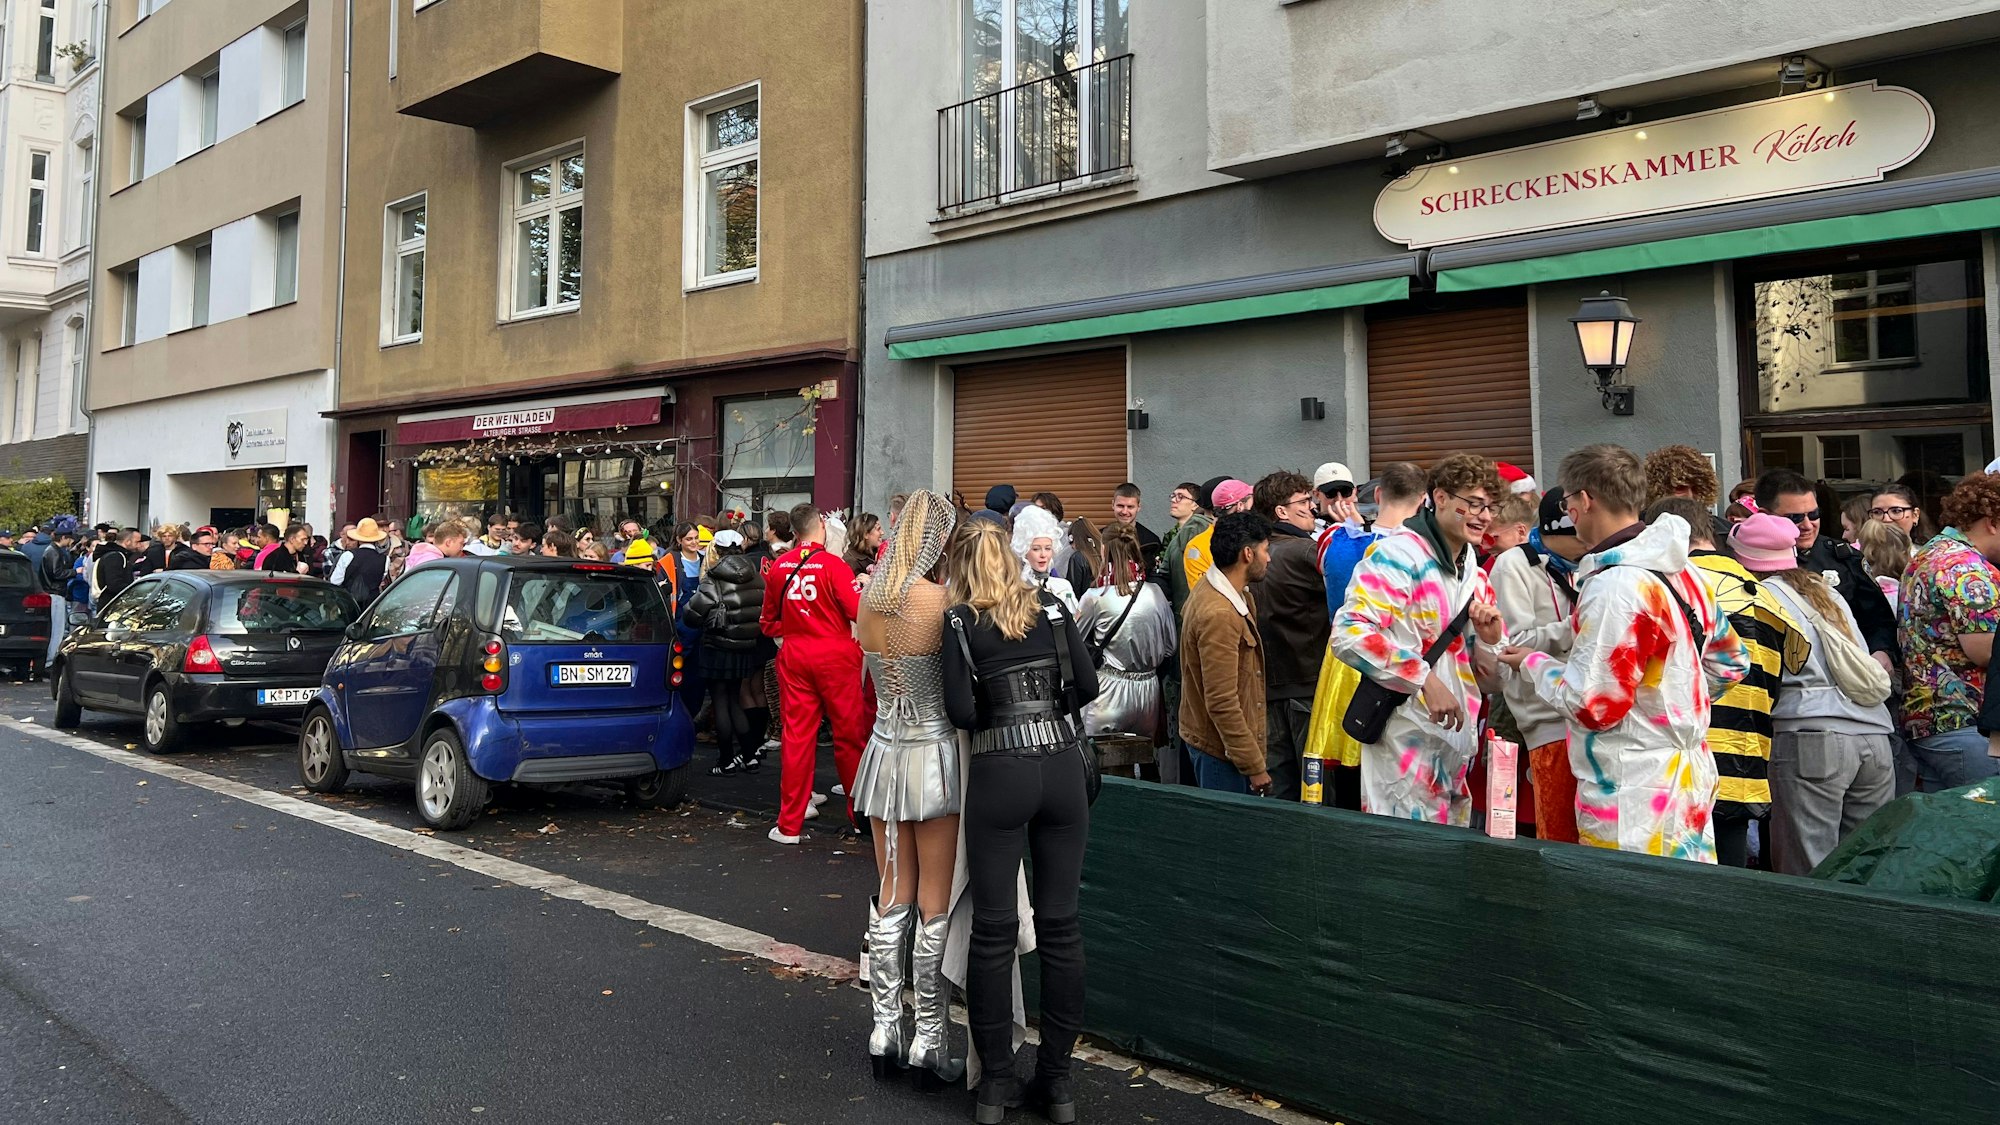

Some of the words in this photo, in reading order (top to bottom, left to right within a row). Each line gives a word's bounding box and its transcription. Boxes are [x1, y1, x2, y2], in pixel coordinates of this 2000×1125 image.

[1419, 143, 1741, 217] SCHRECKENSKAMMER
[1752, 119, 1860, 165] Kölsch
[476, 416, 494, 428] DER
[496, 411, 552, 425] WEINLADEN
[518, 426, 541, 434] STRASSE
[786, 574, 817, 601] 26
[560, 667, 578, 681] BN
[587, 667, 604, 681] SM
[606, 667, 629, 681] 227
[270, 690, 277, 701] K
[285, 690, 299, 701] PT
[302, 689, 320, 700] 67
